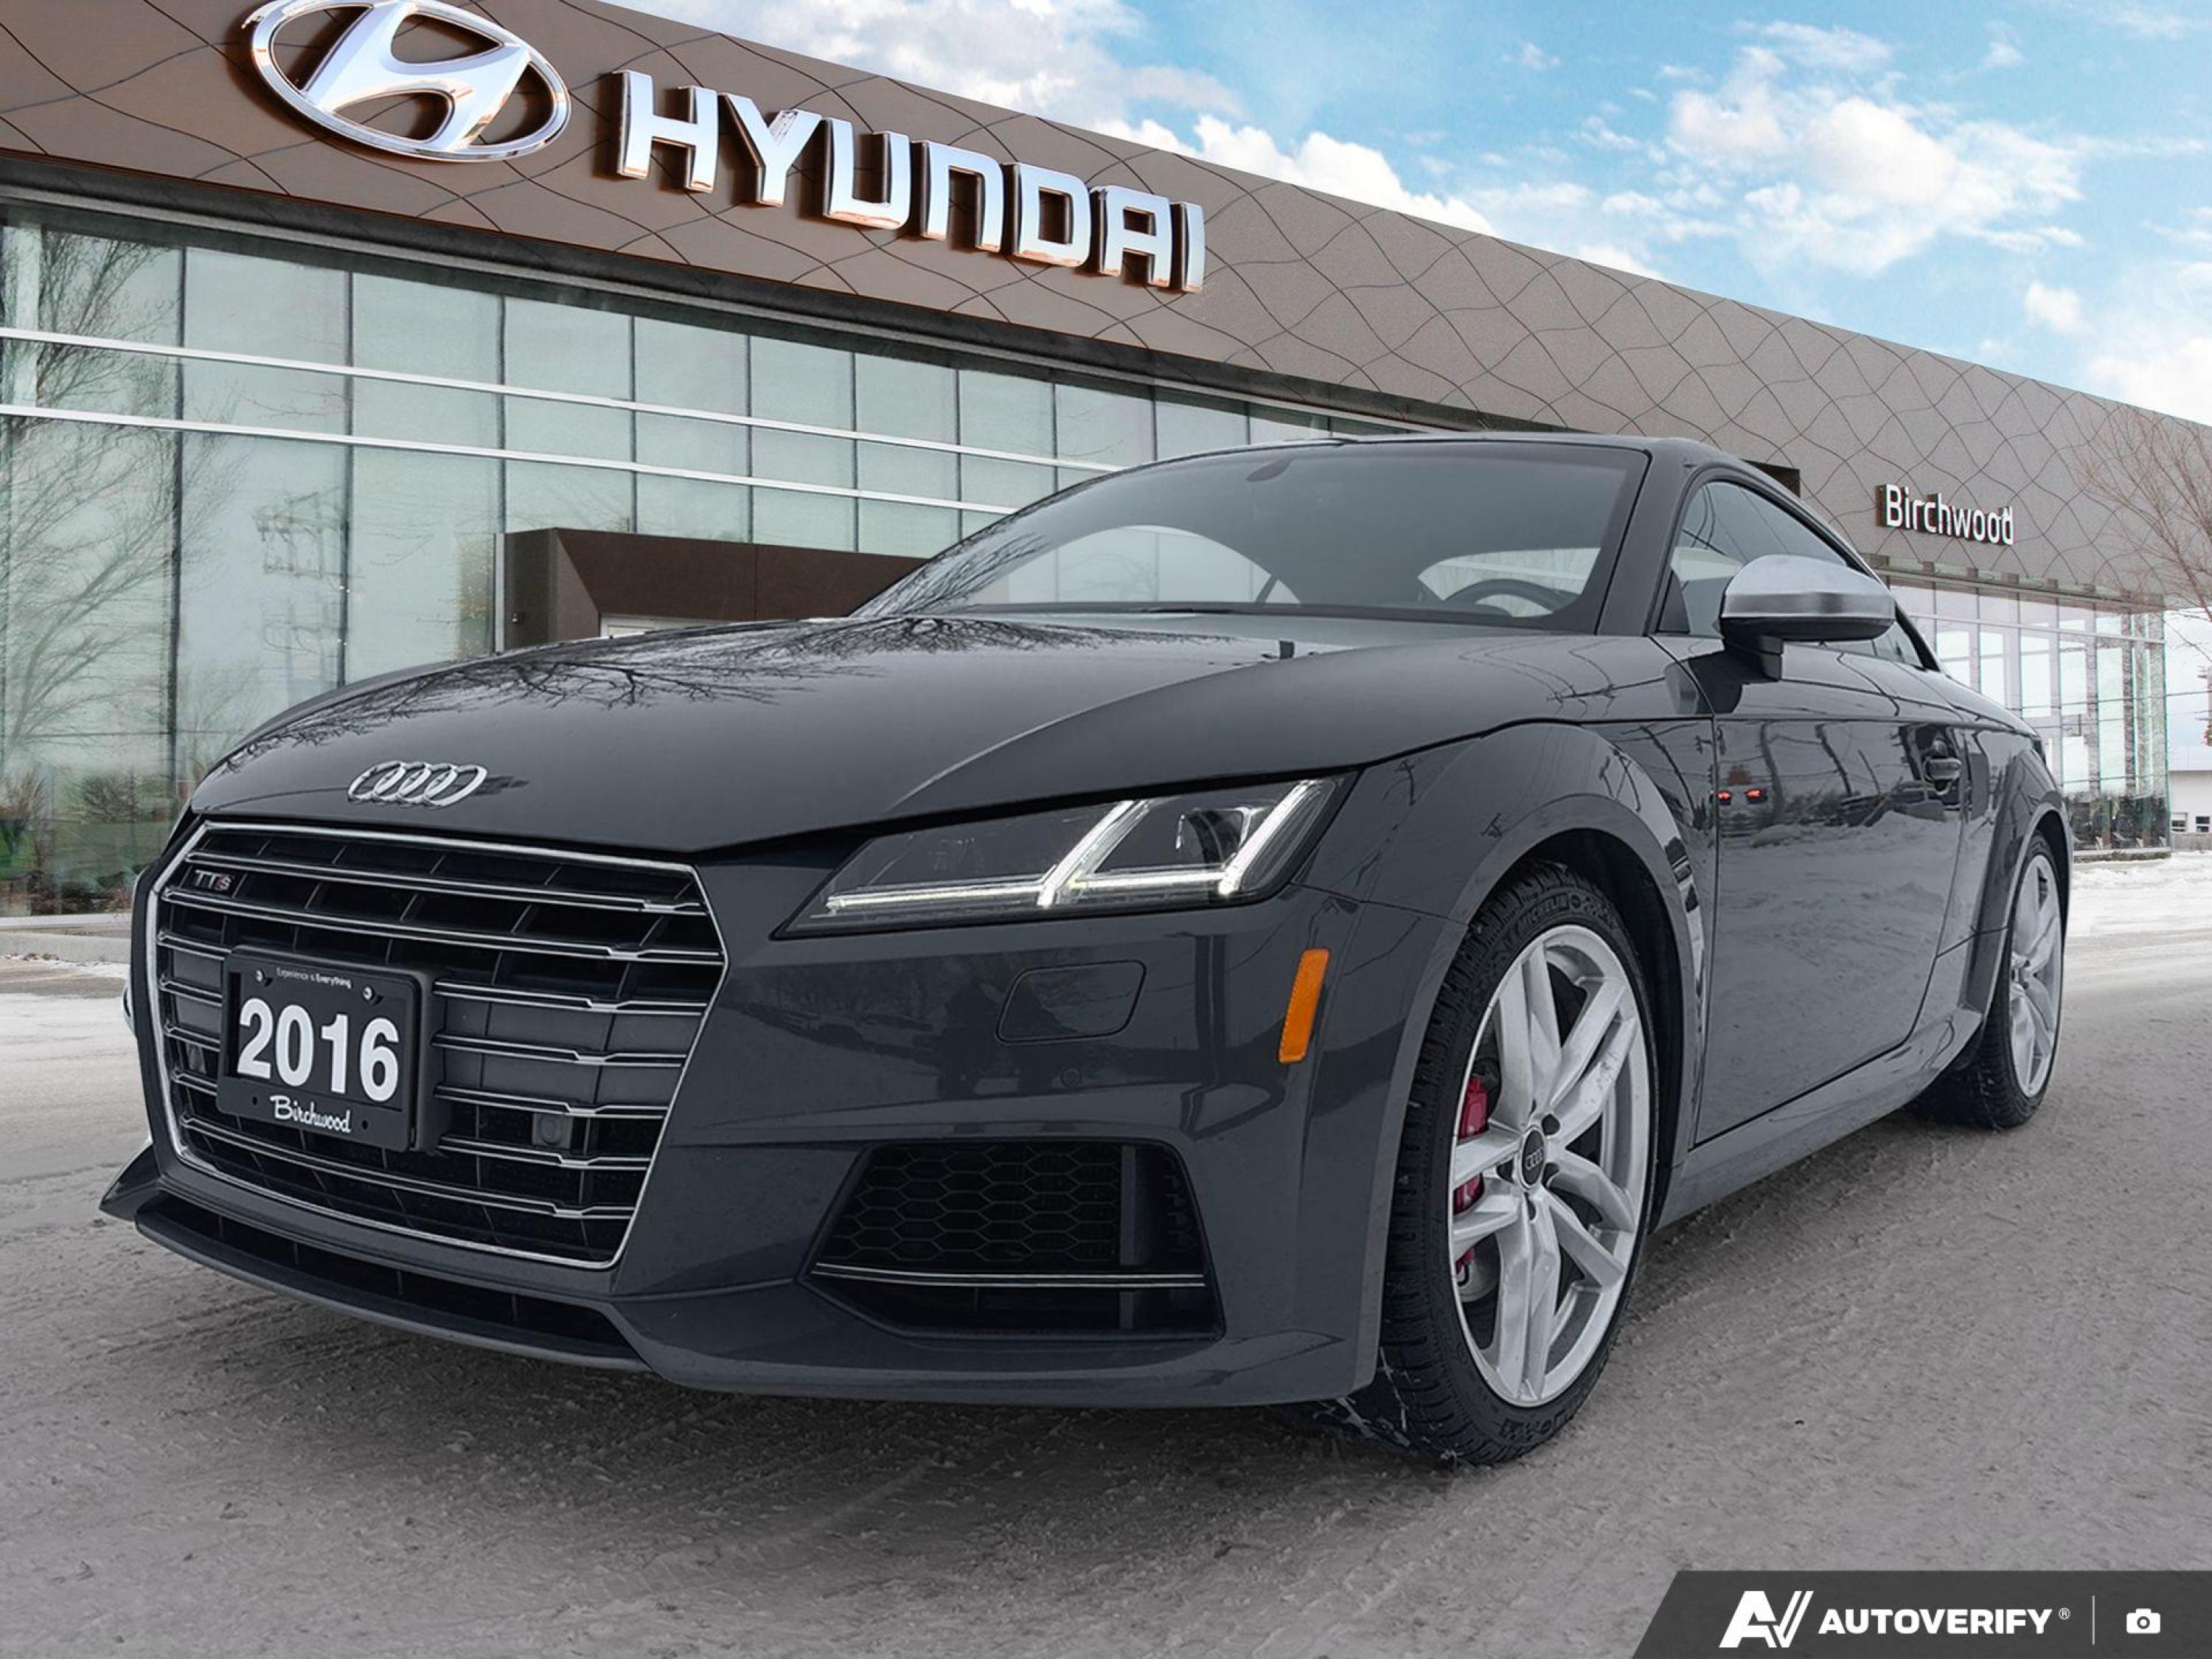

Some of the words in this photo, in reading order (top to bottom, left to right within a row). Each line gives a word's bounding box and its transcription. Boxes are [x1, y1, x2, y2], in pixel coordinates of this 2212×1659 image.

[613, 70, 1206, 293] HYUNDAI
[1885, 483, 2014, 546] Birchwood
[237, 998, 400, 1102] 2016
[269, 1095, 352, 1133] Birchwood
